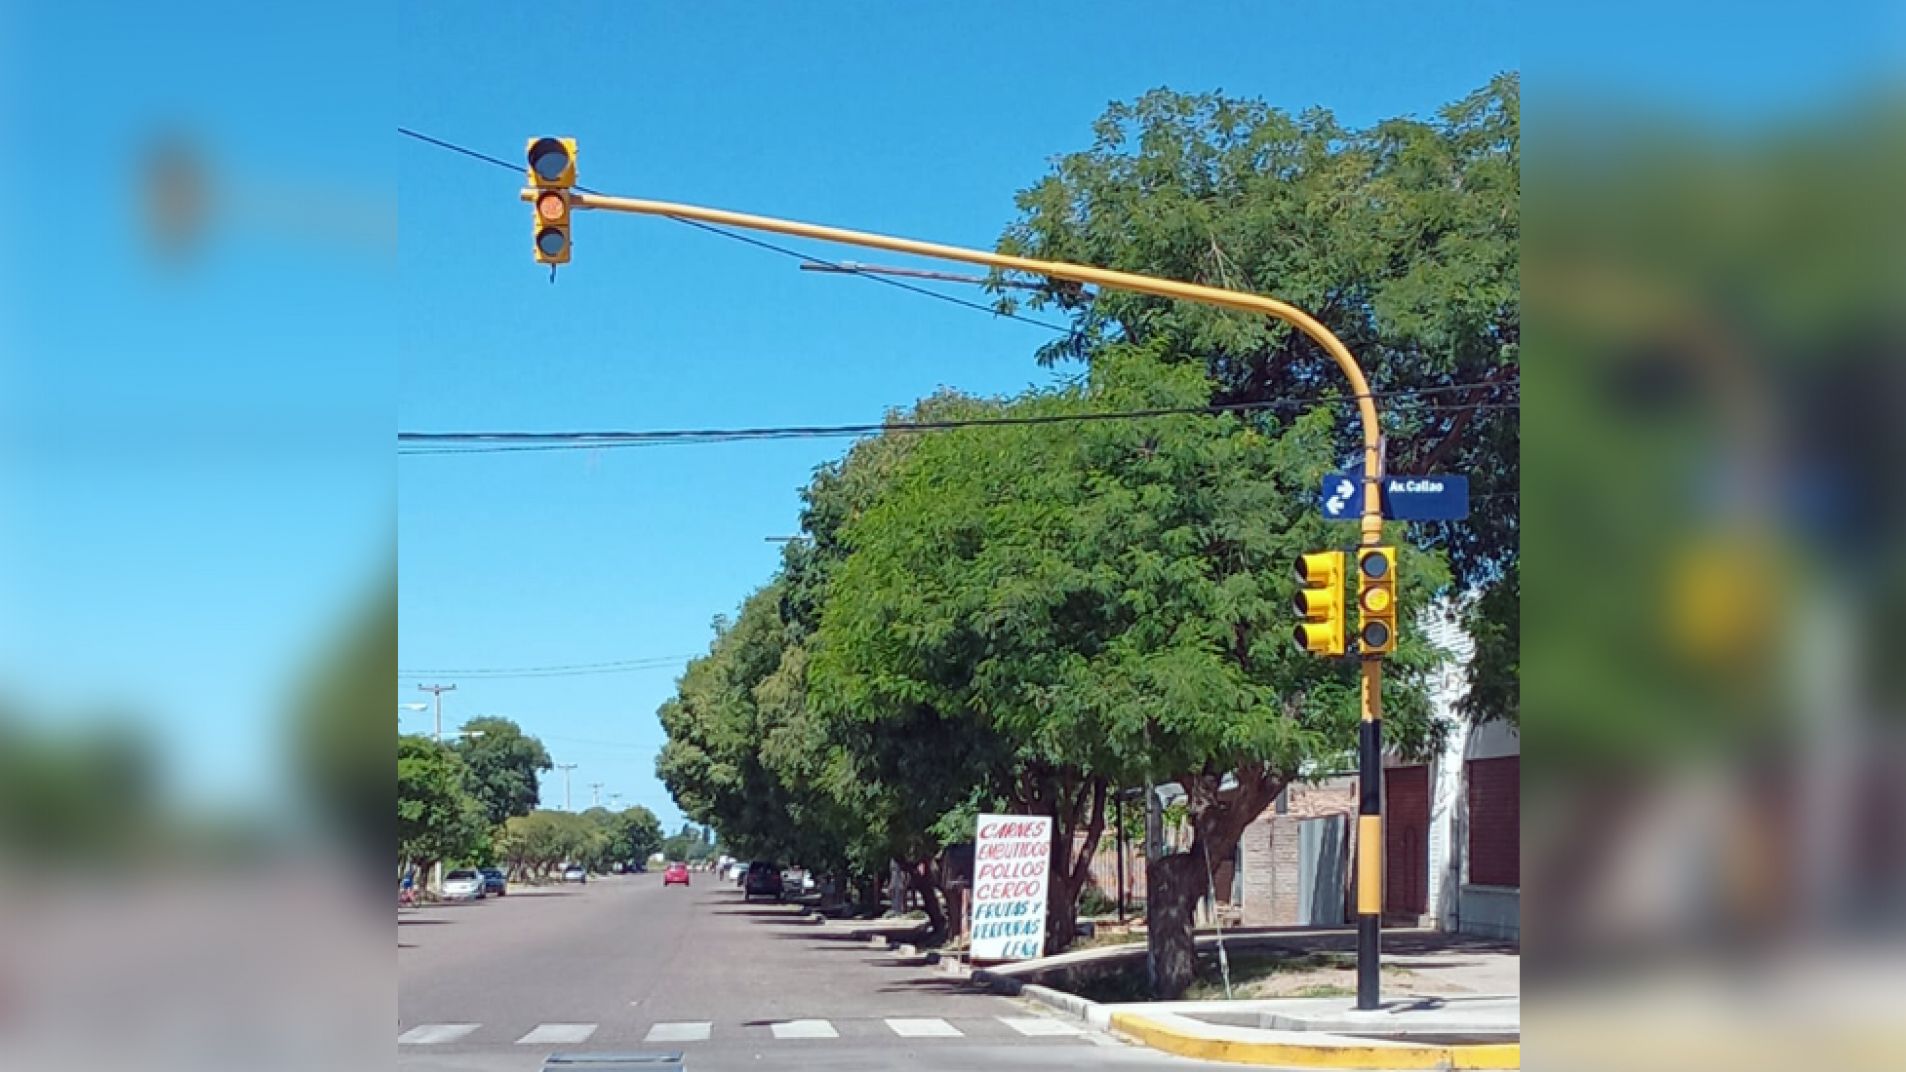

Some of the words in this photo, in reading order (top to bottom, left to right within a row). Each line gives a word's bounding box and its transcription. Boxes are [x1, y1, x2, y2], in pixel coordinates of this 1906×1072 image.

[1406, 480, 1444, 492] Callao
[979, 821, 1047, 839] CARNES
[977, 841, 1050, 860] EMBUTIDOS
[978, 861, 1046, 880] POLLOS
[976, 880, 1041, 899] CERDO
[973, 918, 1041, 940] VERDURAS
